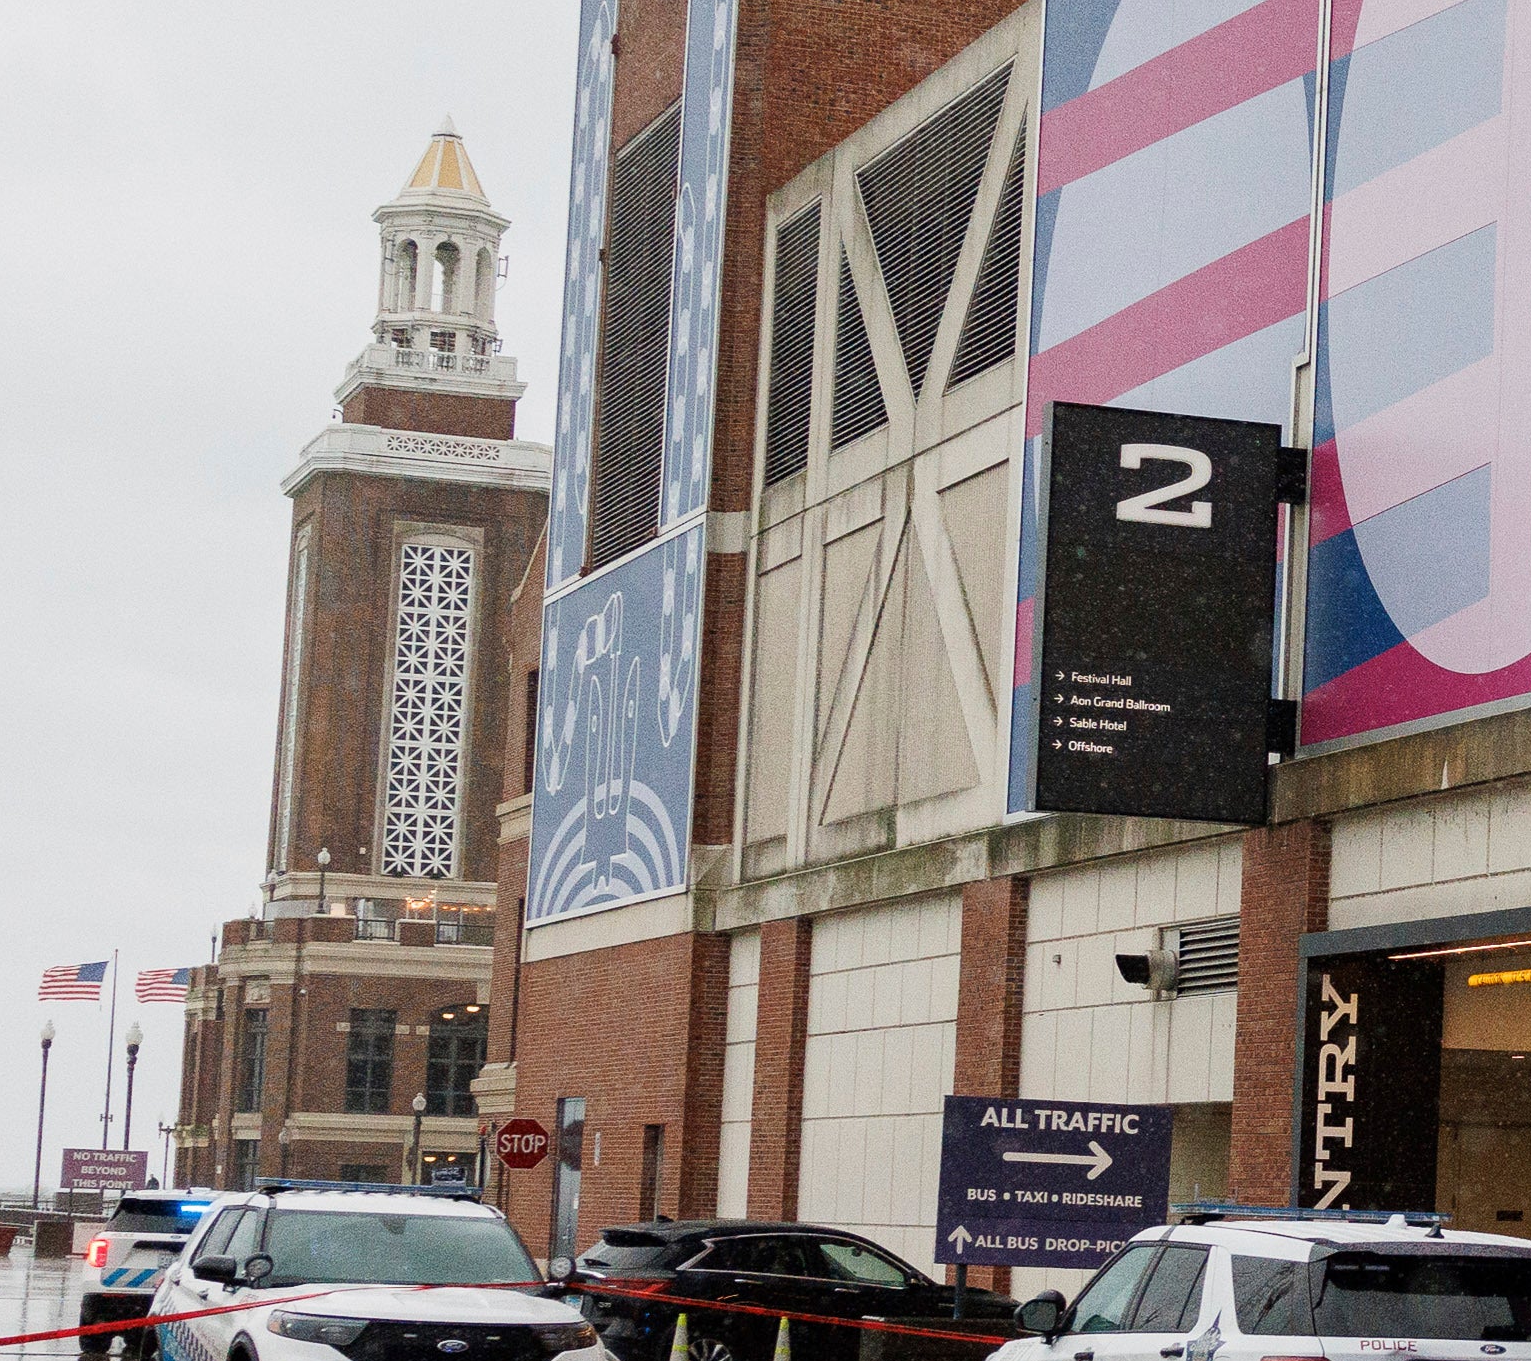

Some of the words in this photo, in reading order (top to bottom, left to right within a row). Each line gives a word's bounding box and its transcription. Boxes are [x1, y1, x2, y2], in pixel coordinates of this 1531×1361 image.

[1116, 443, 1212, 529] 2
[1071, 671, 1110, 684] Festival
[1111, 675, 1132, 686] Hall
[1070, 695, 1091, 706] Aon
[1093, 696, 1124, 708] Grand
[1125, 699, 1171, 712] Ballroom
[1069, 717, 1097, 729] Sable
[1099, 719, 1127, 731] Hotel
[1068, 740, 1113, 753] Offshore
[1313, 974, 1358, 1210] NTRY
[980, 1106, 1029, 1129] ALL
[1034, 1109, 1140, 1135] TRAFFIC
[499, 1133, 546, 1153] STOP
[73, 1151, 90, 1161] NO
[92, 1152, 137, 1162] TRAFFIC
[81, 1165, 127, 1175] BEYOND
[72, 1179, 97, 1187] THIS
[99, 1179, 133, 1189] POINT
[967, 1189, 997, 1201] BUS
[1015, 1190, 1048, 1203] TAXI
[1062, 1193, 1143, 1208] RIDESHARE
[975, 1235, 1004, 1248] ALL
[1007, 1236, 1038, 1250] BUS
[1360, 1339, 1418, 1352] POLICE
